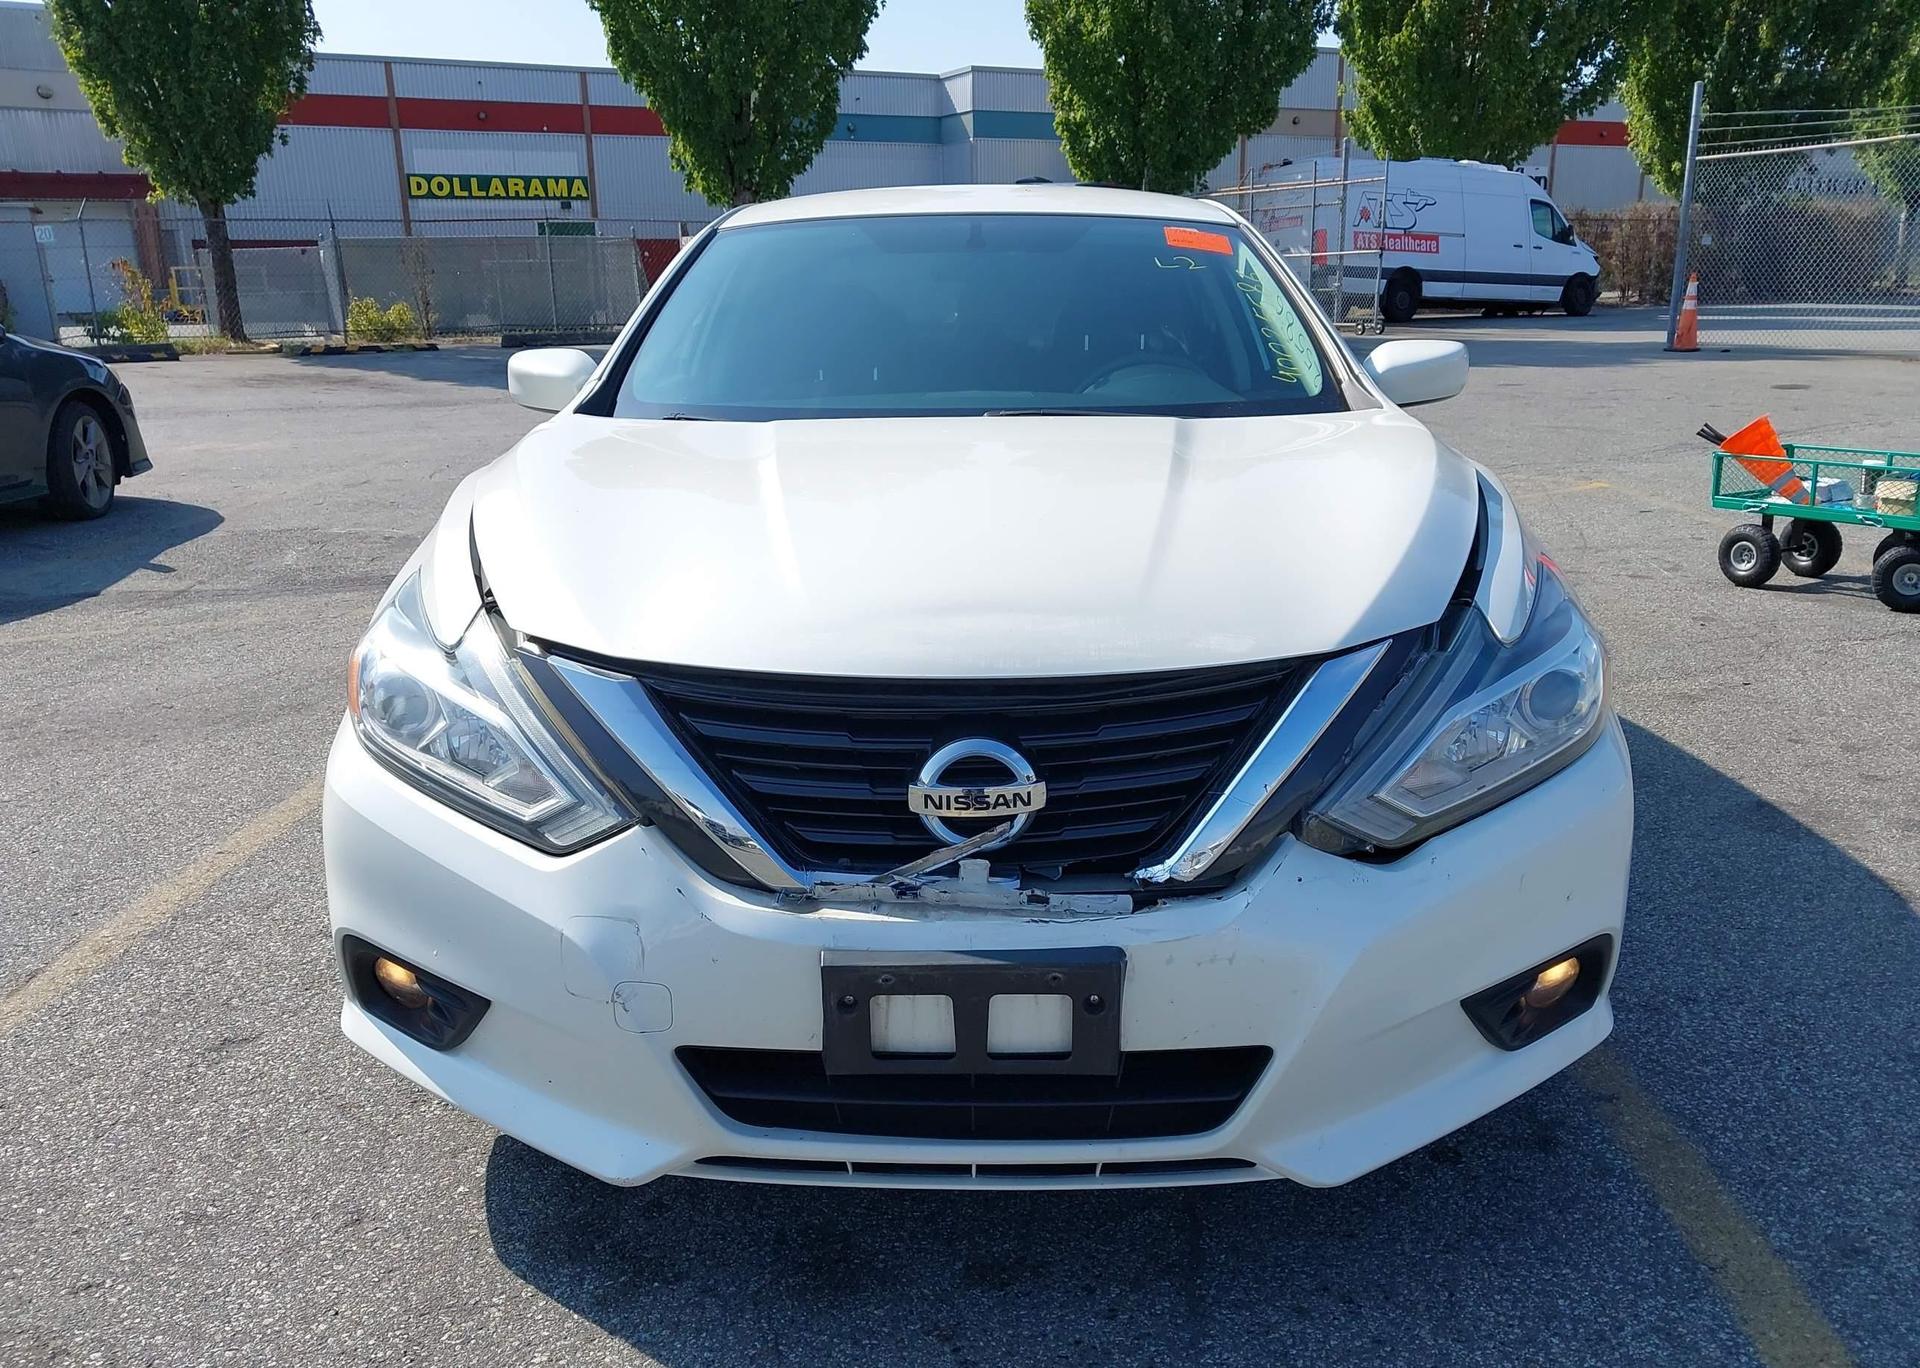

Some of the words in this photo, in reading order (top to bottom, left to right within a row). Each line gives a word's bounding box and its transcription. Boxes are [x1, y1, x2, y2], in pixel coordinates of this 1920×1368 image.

[409, 176, 588, 198] DOLLARAMA
[37, 227, 52, 240] 20
[1356, 233, 1378, 249] ATS
[923, 790, 1032, 811] NISSAN
